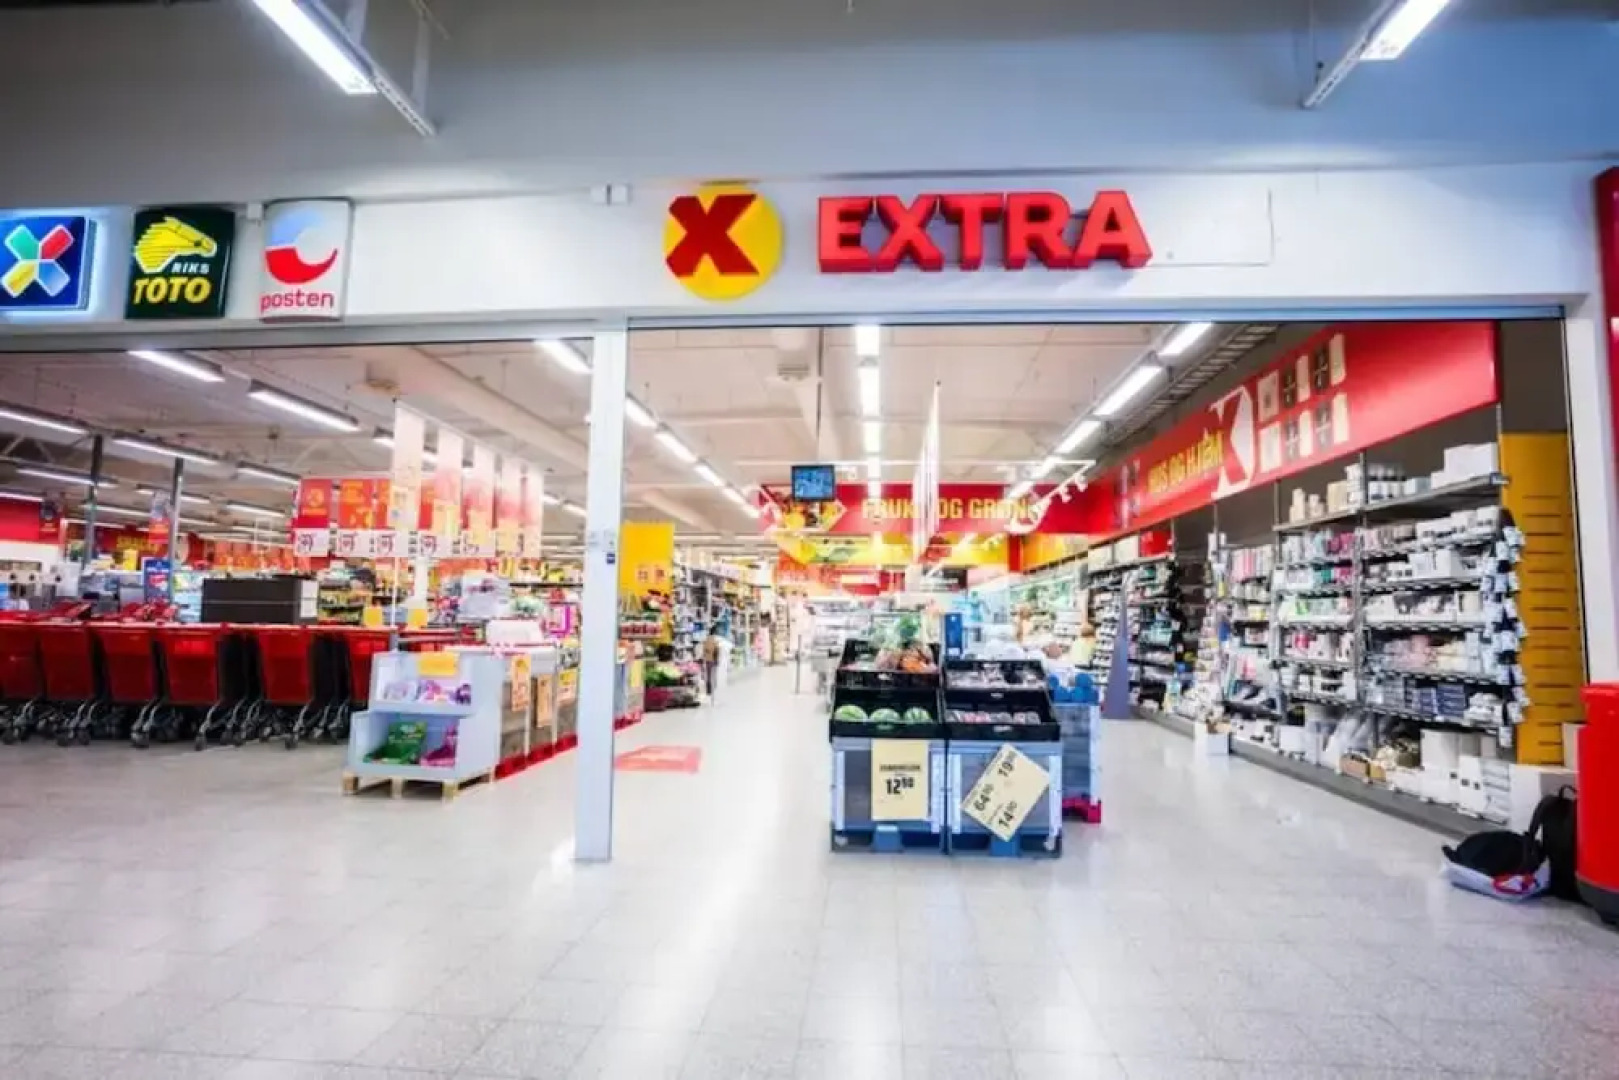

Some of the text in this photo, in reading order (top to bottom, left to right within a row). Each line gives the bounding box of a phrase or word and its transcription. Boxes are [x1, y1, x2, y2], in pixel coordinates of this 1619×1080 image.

[817, 190, 1153, 275] EXTRA
[171, 261, 210, 275] RIKS
[133, 277, 212, 304] TOTO
[260, 290, 335, 313] posten
[938, 497, 964, 519] OG
